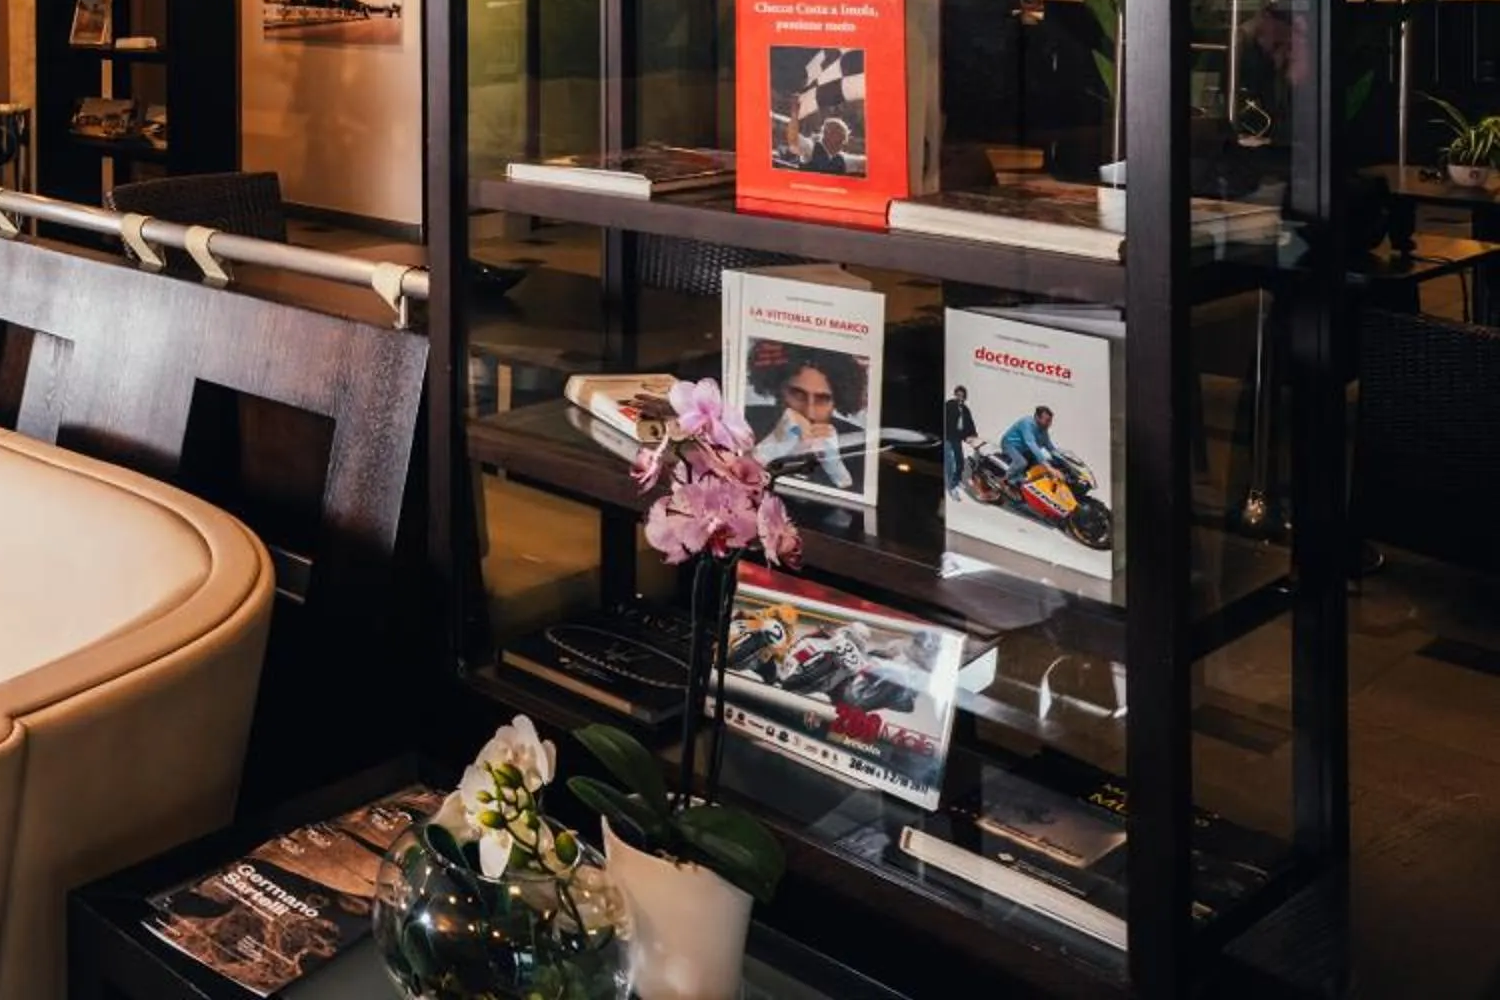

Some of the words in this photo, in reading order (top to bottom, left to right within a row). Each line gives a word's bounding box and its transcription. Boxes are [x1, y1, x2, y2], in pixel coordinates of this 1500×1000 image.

[749, 306, 763, 317] LA
[766, 309, 813, 325] VITTORIA
[815, 316, 827, 327] DI
[829, 319, 870, 335] MARCO
[974, 346, 1073, 380] doctorcosta
[222, 870, 290, 917] Sartelli
[236, 863, 319, 918] Germano
